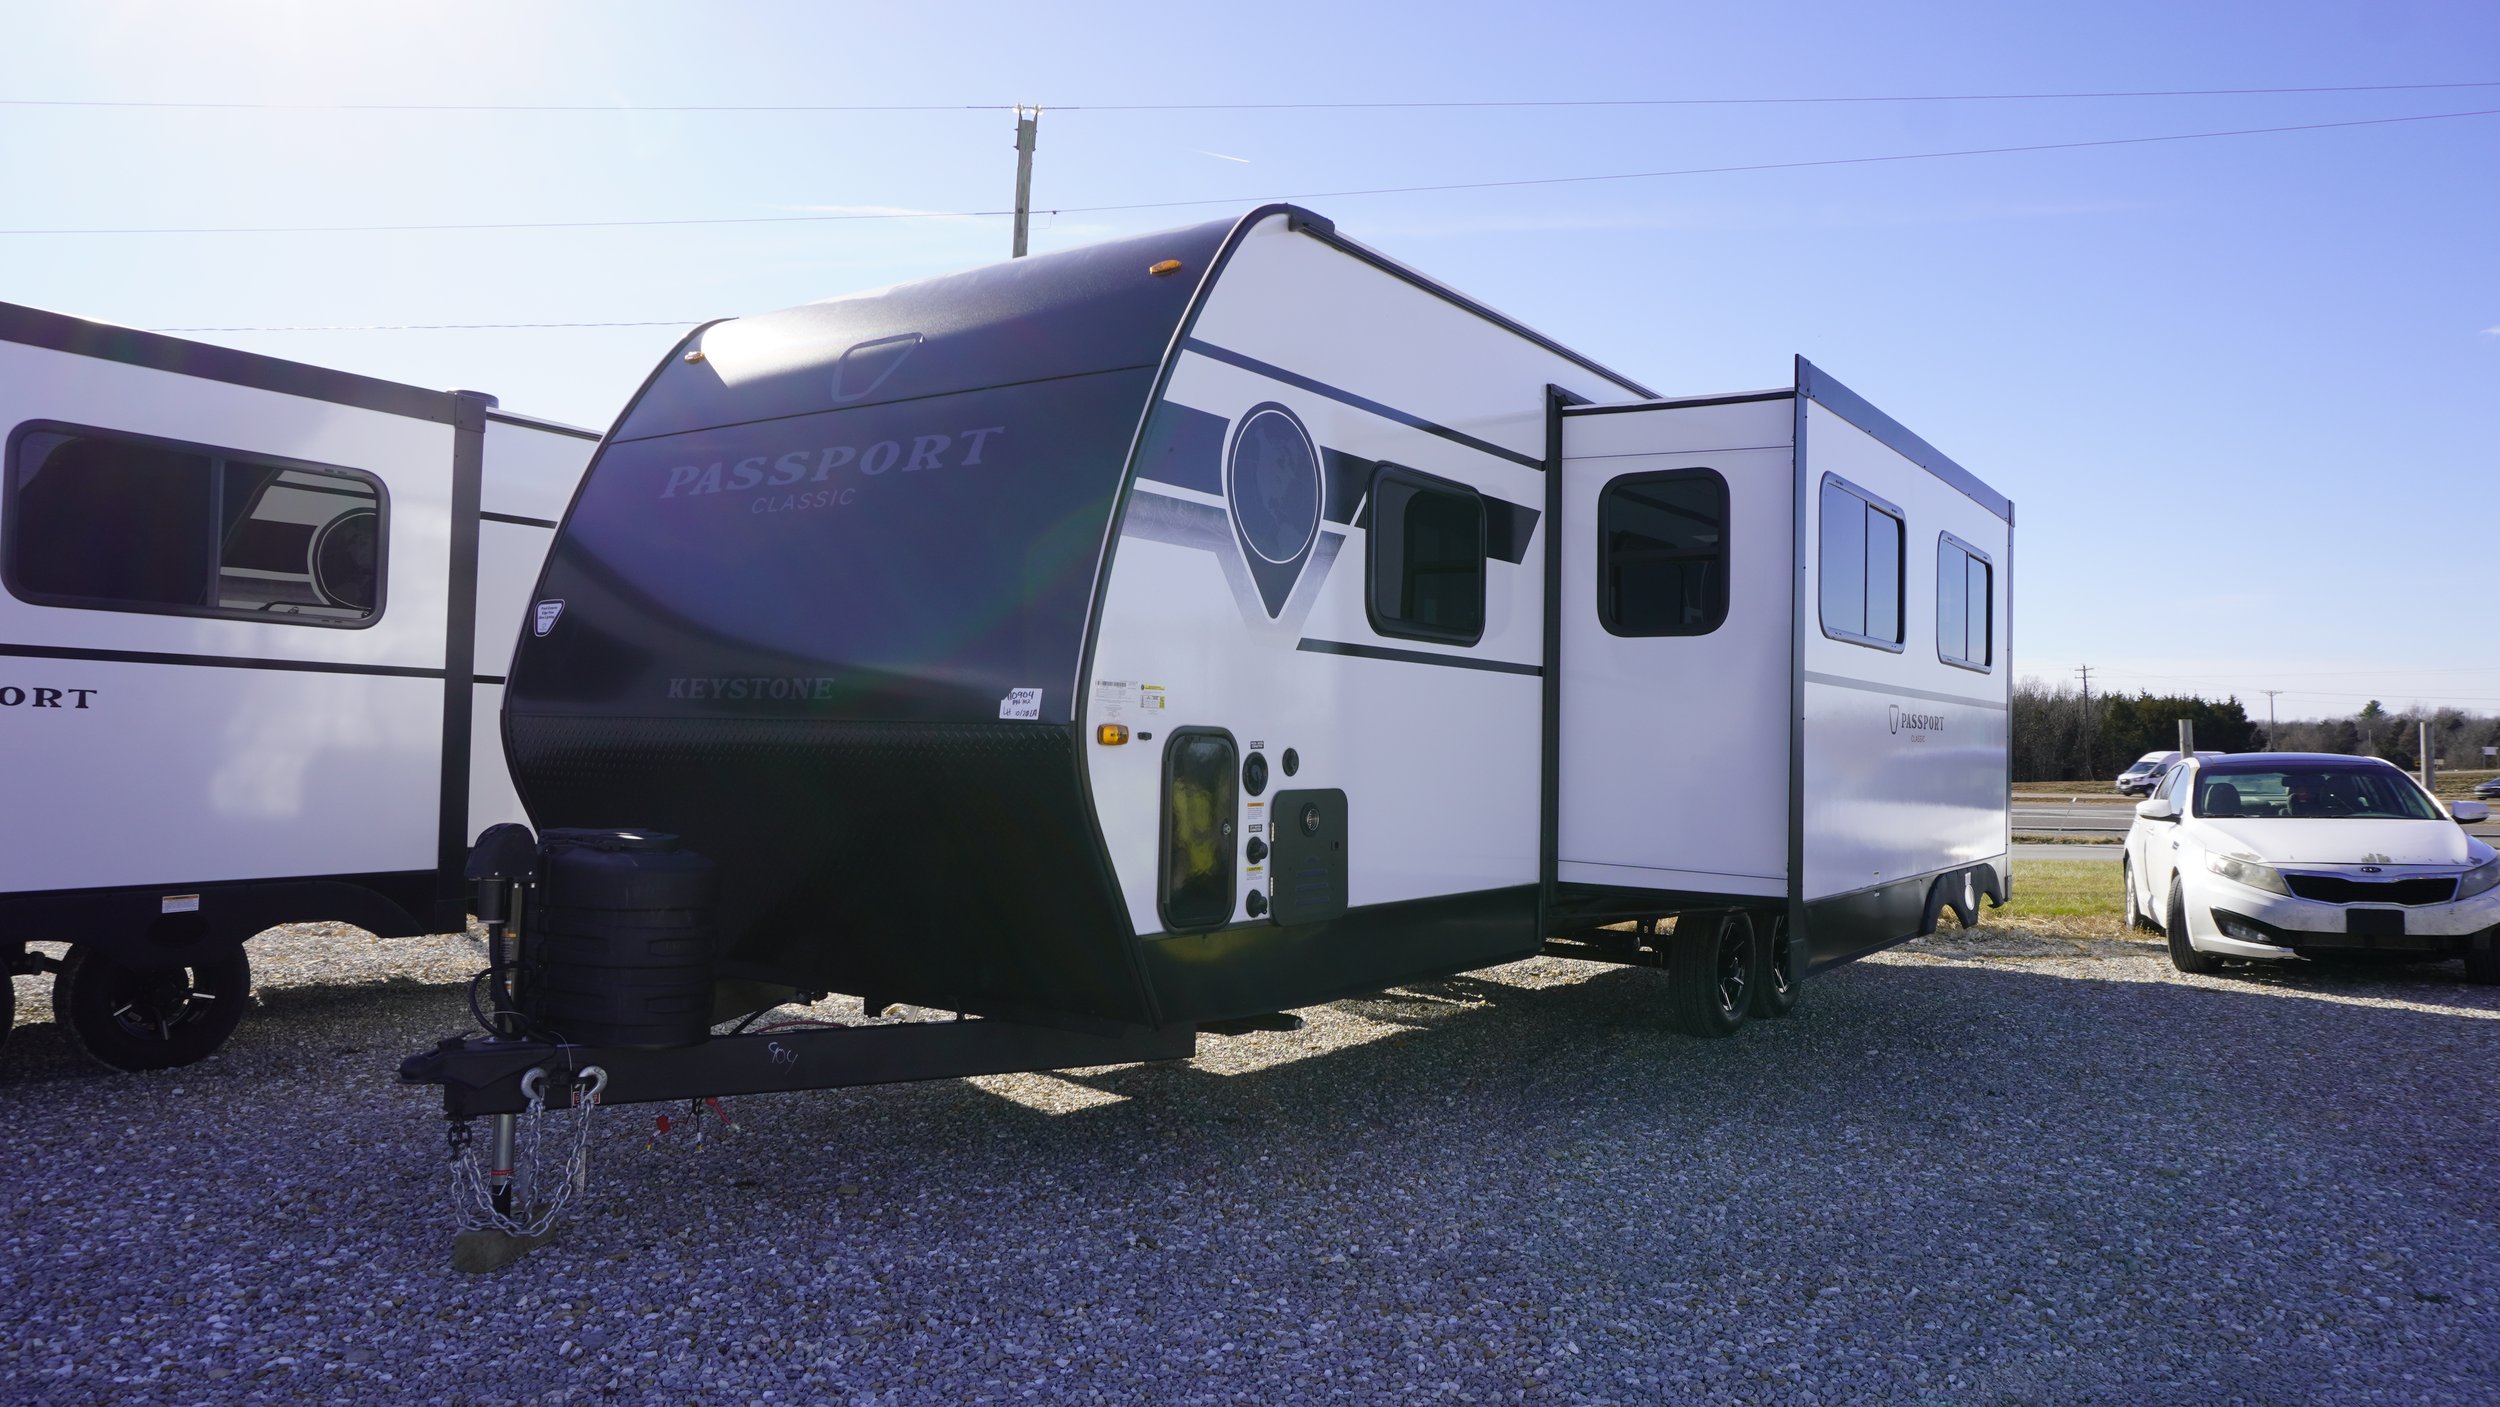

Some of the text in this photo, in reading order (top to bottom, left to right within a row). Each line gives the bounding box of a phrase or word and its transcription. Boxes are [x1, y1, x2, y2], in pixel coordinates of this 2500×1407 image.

[659, 426, 1005, 499] PASSPORT
[751, 488, 856, 514] CLASSIC
[667, 677, 835, 700] KEYSTONE
[1901, 712, 1945, 731] PASSPORT
